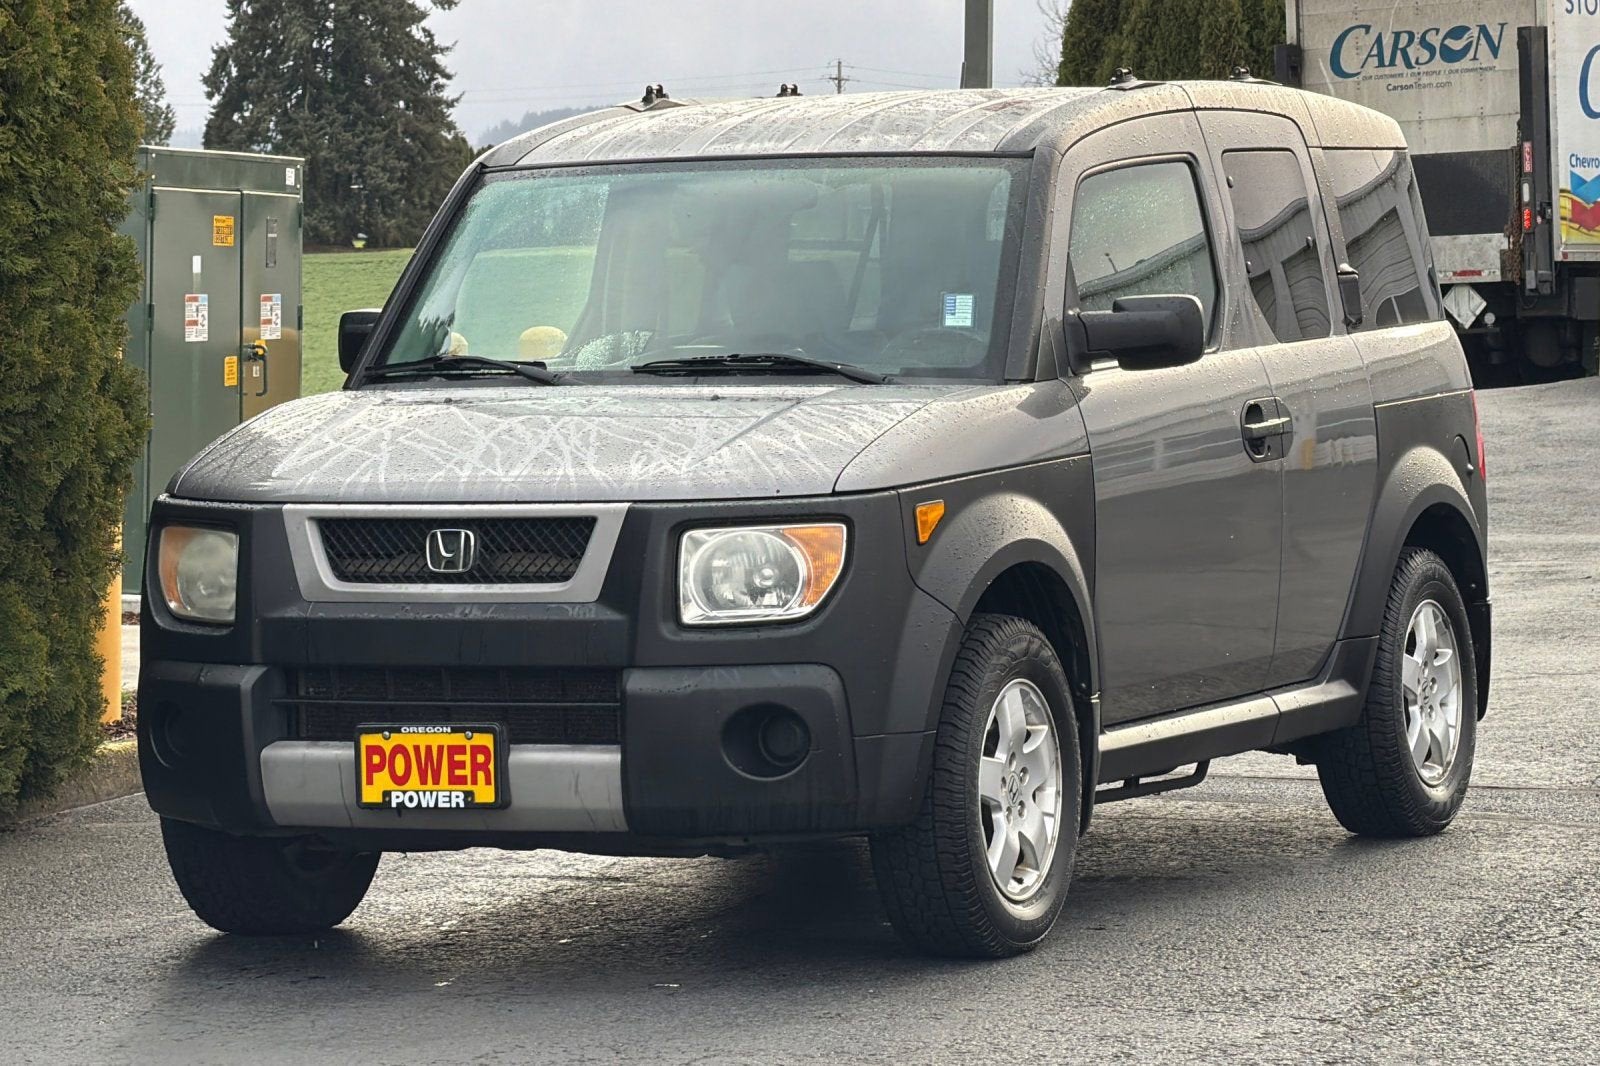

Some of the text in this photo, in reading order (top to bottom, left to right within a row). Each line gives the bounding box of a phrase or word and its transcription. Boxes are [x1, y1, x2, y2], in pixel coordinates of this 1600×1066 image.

[1386, 81, 1453, 92] CarsonTeam.com
[1569, 153, 1600, 168] Chevro
[365, 743, 492, 786] POWER
[391, 790, 465, 808] POWER
